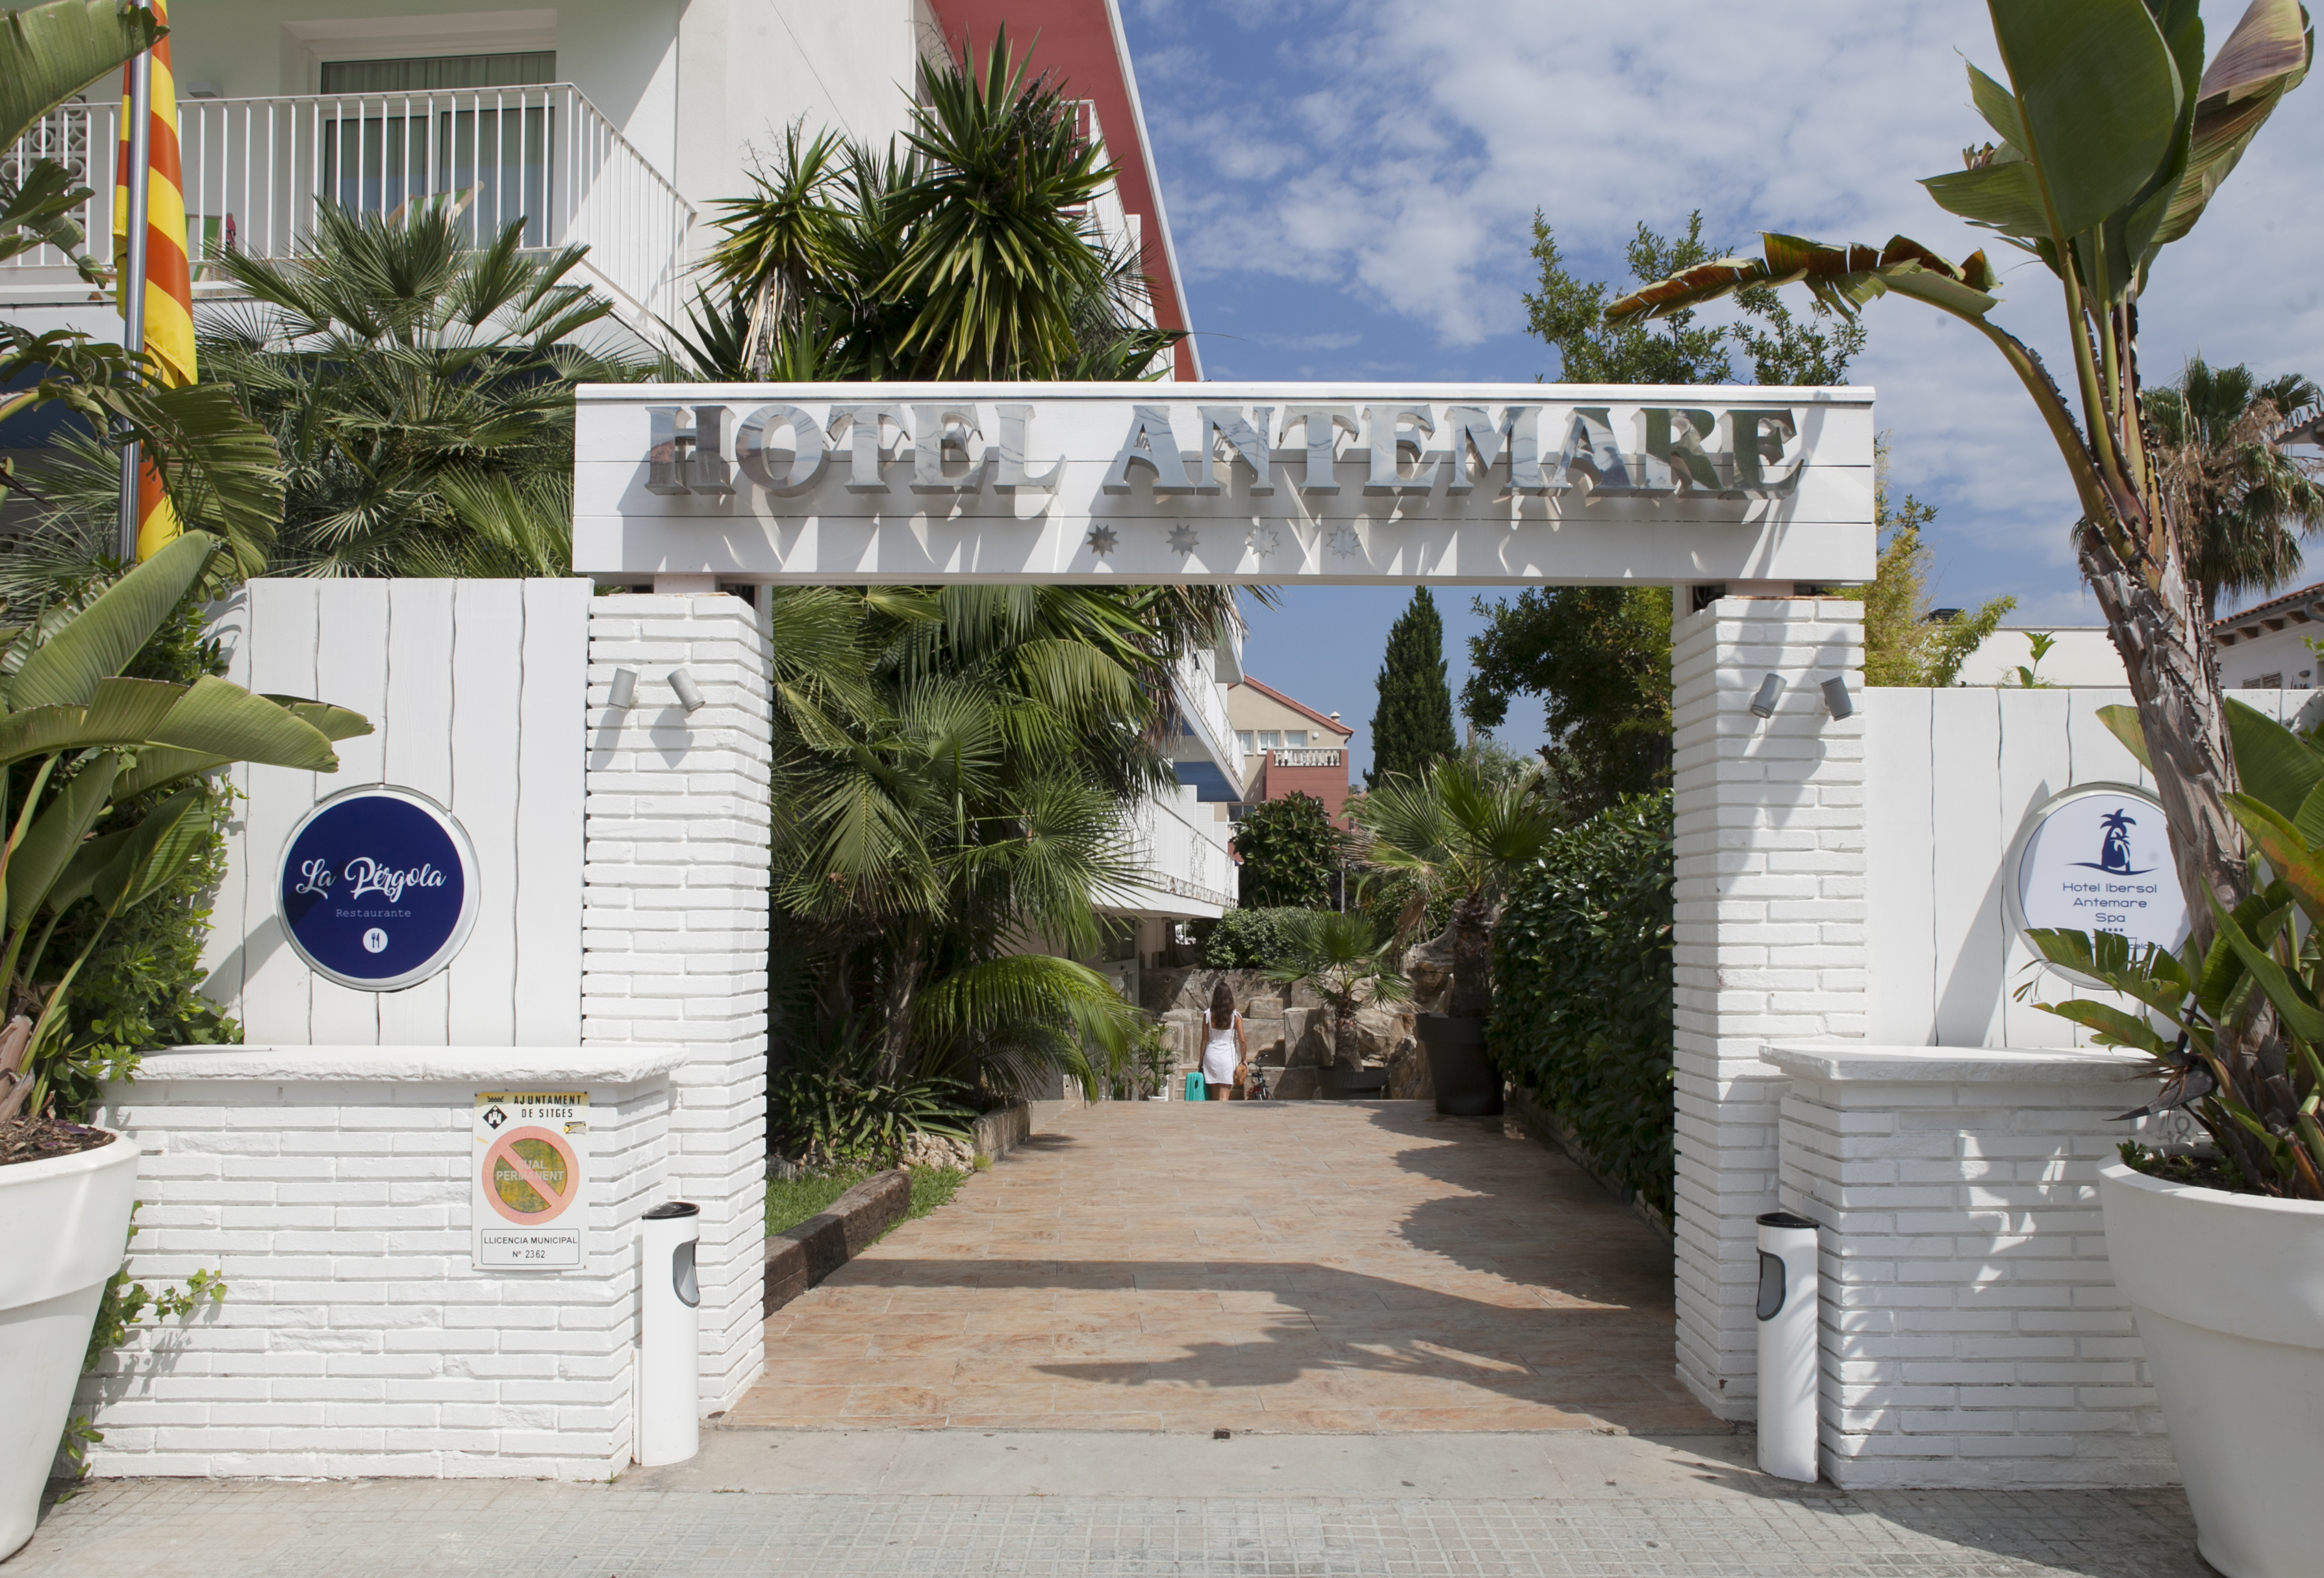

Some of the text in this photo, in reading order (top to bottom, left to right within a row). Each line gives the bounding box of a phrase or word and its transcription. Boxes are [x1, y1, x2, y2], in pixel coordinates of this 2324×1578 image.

[644, 403, 1804, 500] HOTEL ANTEMARE
[296, 857, 447, 903] La Pérgola
[2063, 883, 2157, 893] Hotel Ibersol
[2073, 897, 2147, 908] Antemare
[2095, 912, 2125, 923] Spa
[514, 1096, 581, 1105] AJUNTAMENT
[522, 1108, 573, 1118] DE SITGES
[515, 1160, 547, 1170] GUAL
[496, 1171, 564, 1181] PERMANENT
